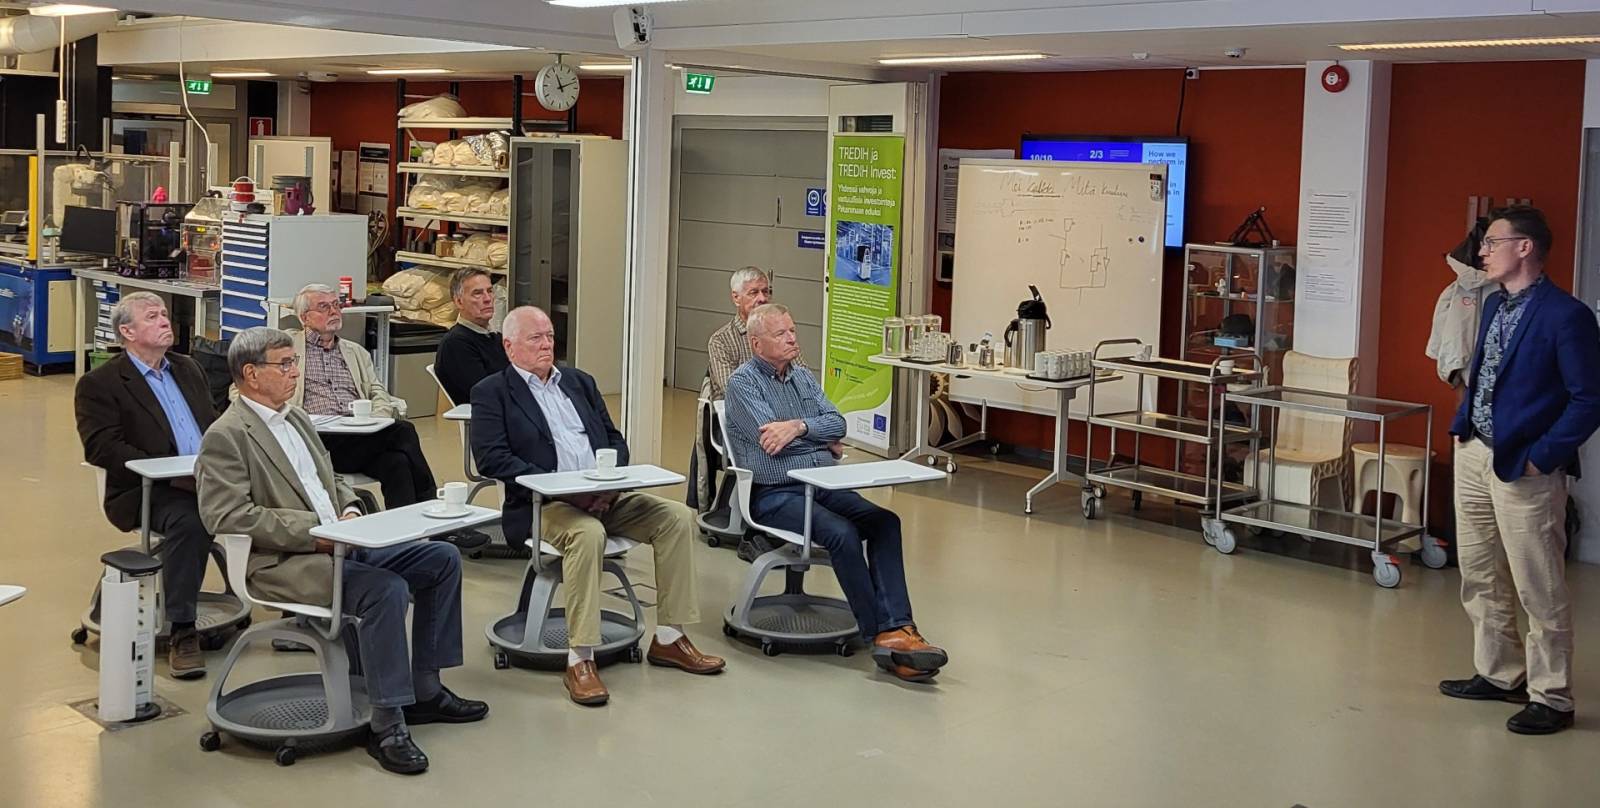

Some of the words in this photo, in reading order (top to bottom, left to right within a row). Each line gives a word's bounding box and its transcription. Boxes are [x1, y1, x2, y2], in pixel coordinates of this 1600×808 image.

[839, 146, 869, 160] TREDIH
[870, 147, 878, 163] ja
[1089, 150, 1104, 159] 2/3
[838, 164, 868, 178] TREDIH
[871, 165, 896, 180] Invest
